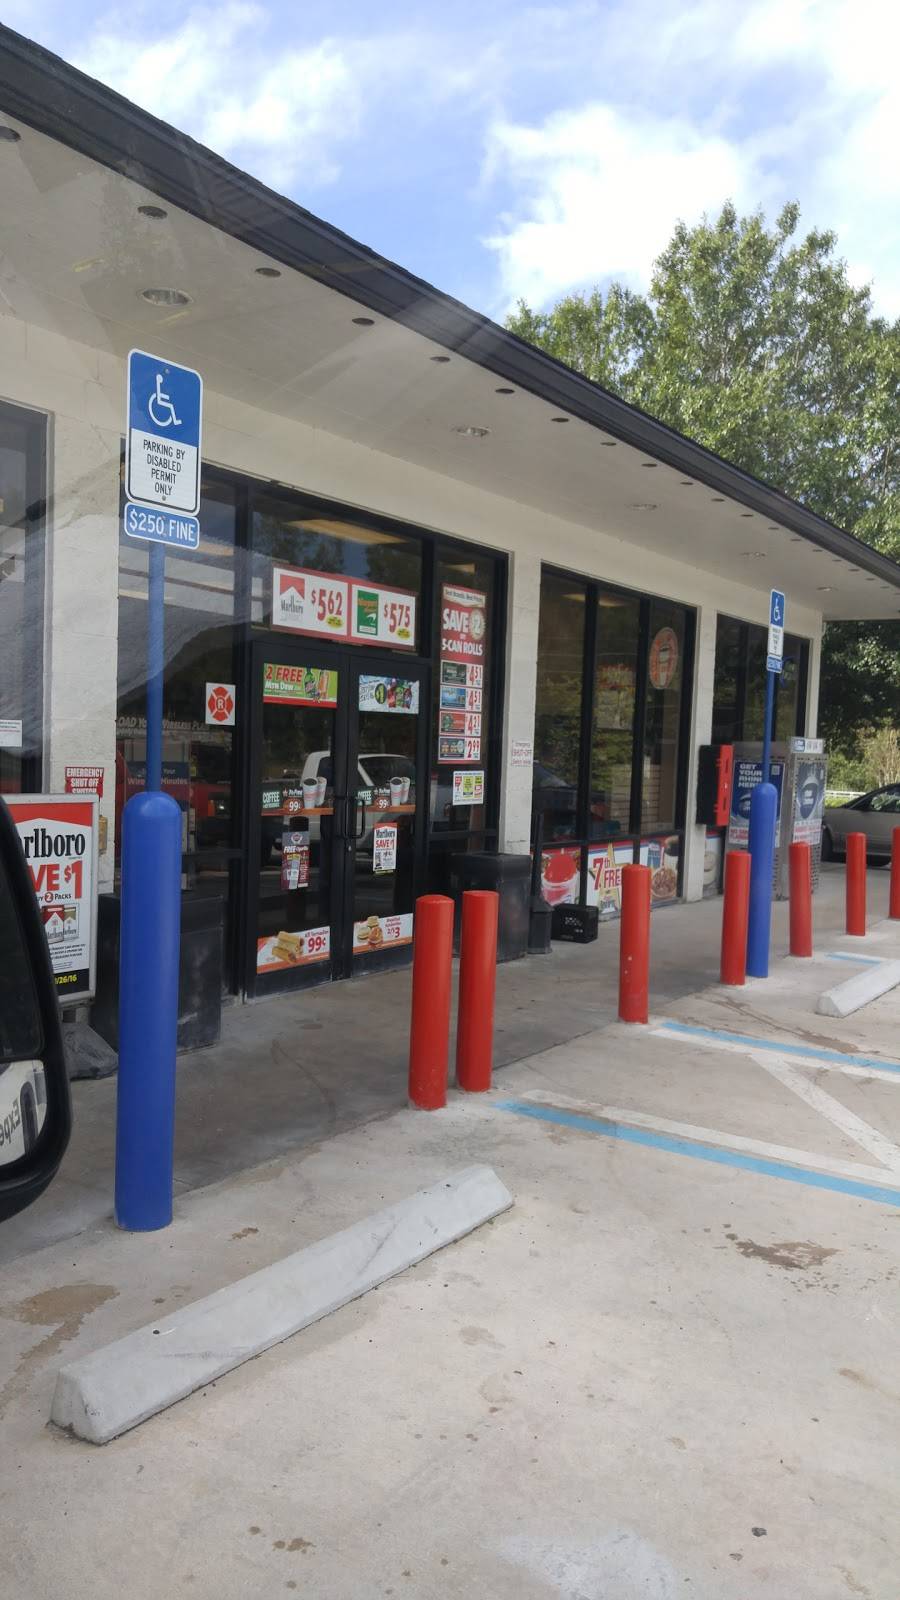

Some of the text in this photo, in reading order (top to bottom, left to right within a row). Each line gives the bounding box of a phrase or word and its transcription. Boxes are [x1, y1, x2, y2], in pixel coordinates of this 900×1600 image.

[143, 439, 186, 460] PARKING BY
[147, 453, 181, 472] DISABLED
[151, 468, 176, 484] PERMIT
[154, 482, 173, 496] ONLY
[129, 508, 196, 542] $250 FINE
[280, 594, 304, 614] Marlboro
[442, 608, 469, 633] SAVE
[463, 642, 483, 656] ROLLS
[265, 665, 303, 683] 2 FREE
[217, 699, 224, 709] R
[66, 767, 104, 777] EMERGENCY
[739, 769, 762, 777] YOUR
[70, 778, 99, 787] SHUT OFF
[262, 791, 280, 803] COFFEE
[375, 828, 395, 838] Marlboro
[284, 845, 296, 853] FREE
[375, 839, 389, 849] SAVE
[604, 868, 621, 888] FRE
[308, 936, 326, 953] 99¢
